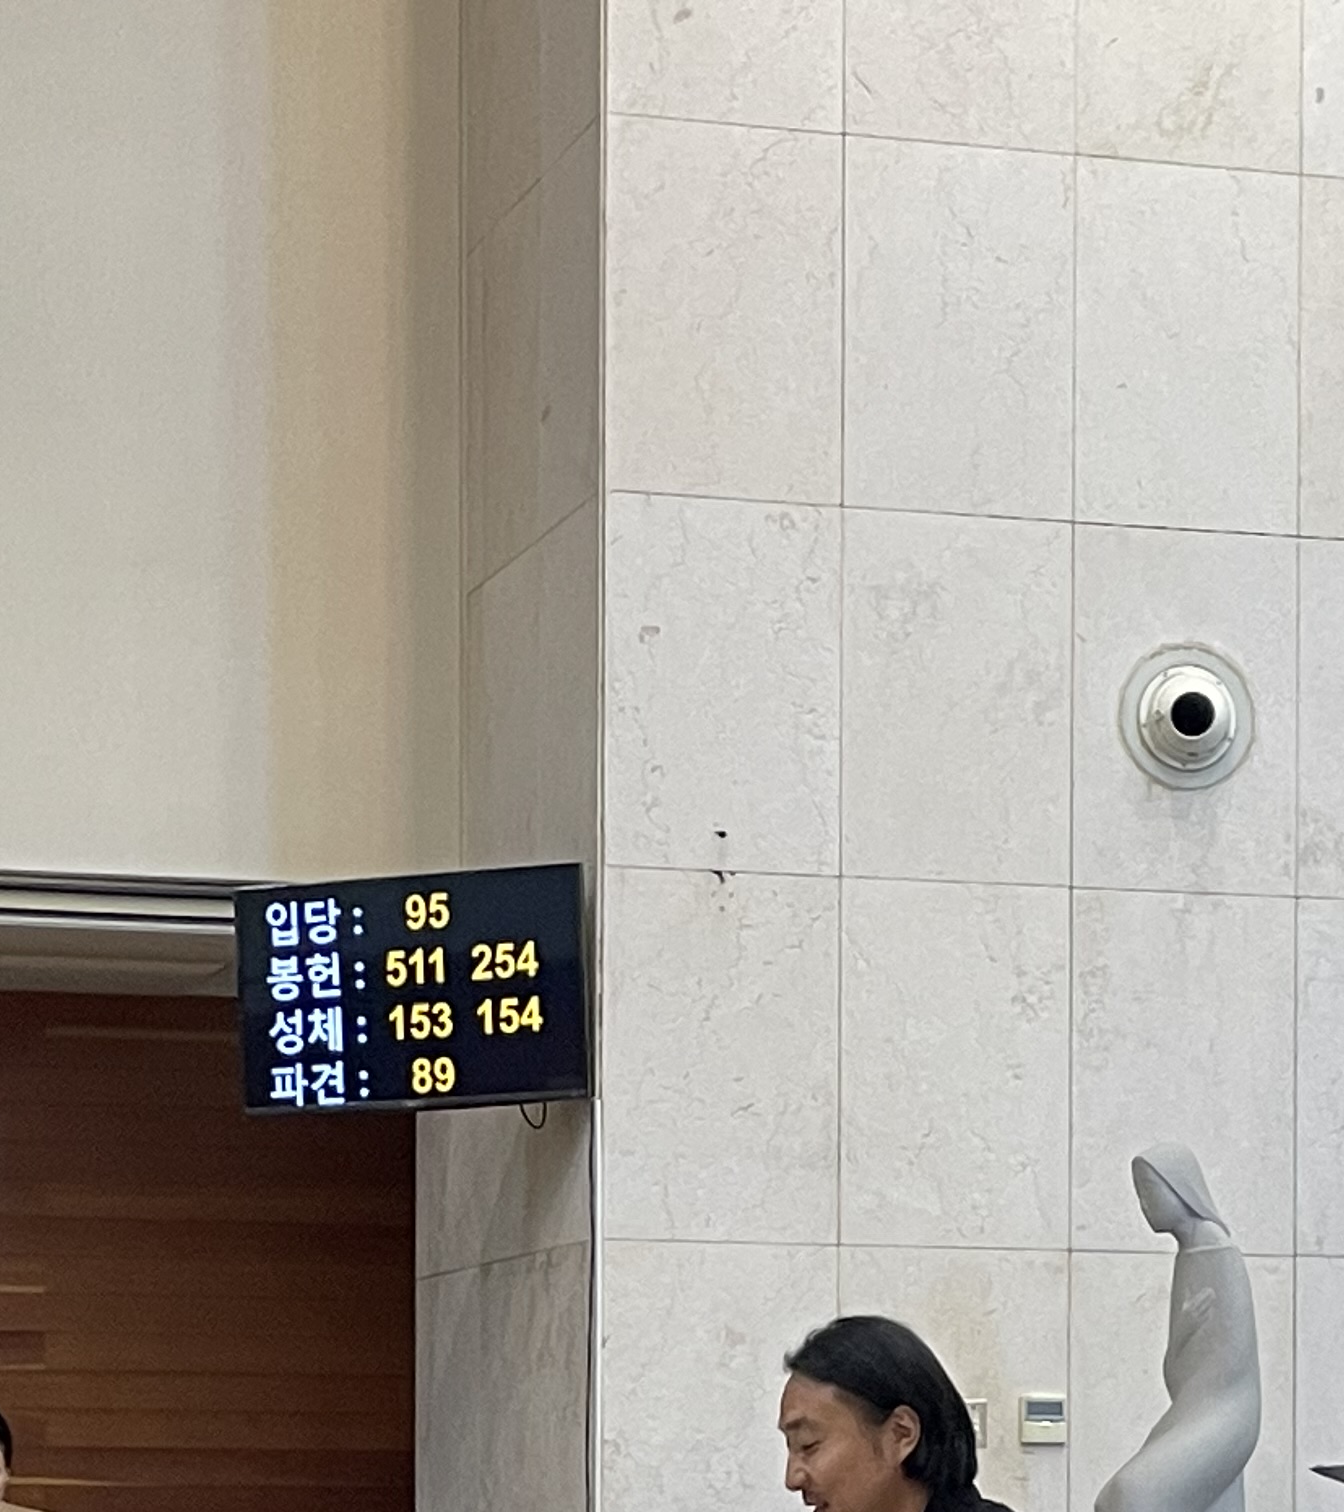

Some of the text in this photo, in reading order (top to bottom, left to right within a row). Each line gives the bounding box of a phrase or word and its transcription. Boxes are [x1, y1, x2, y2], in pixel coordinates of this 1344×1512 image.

[404, 891, 451, 932] 95
[385, 946, 446, 987] 511
[470, 939, 539, 982] 254
[388, 1002, 454, 1041] 153
[476, 995, 544, 1035] 154
[411, 1056, 456, 1094] 89
